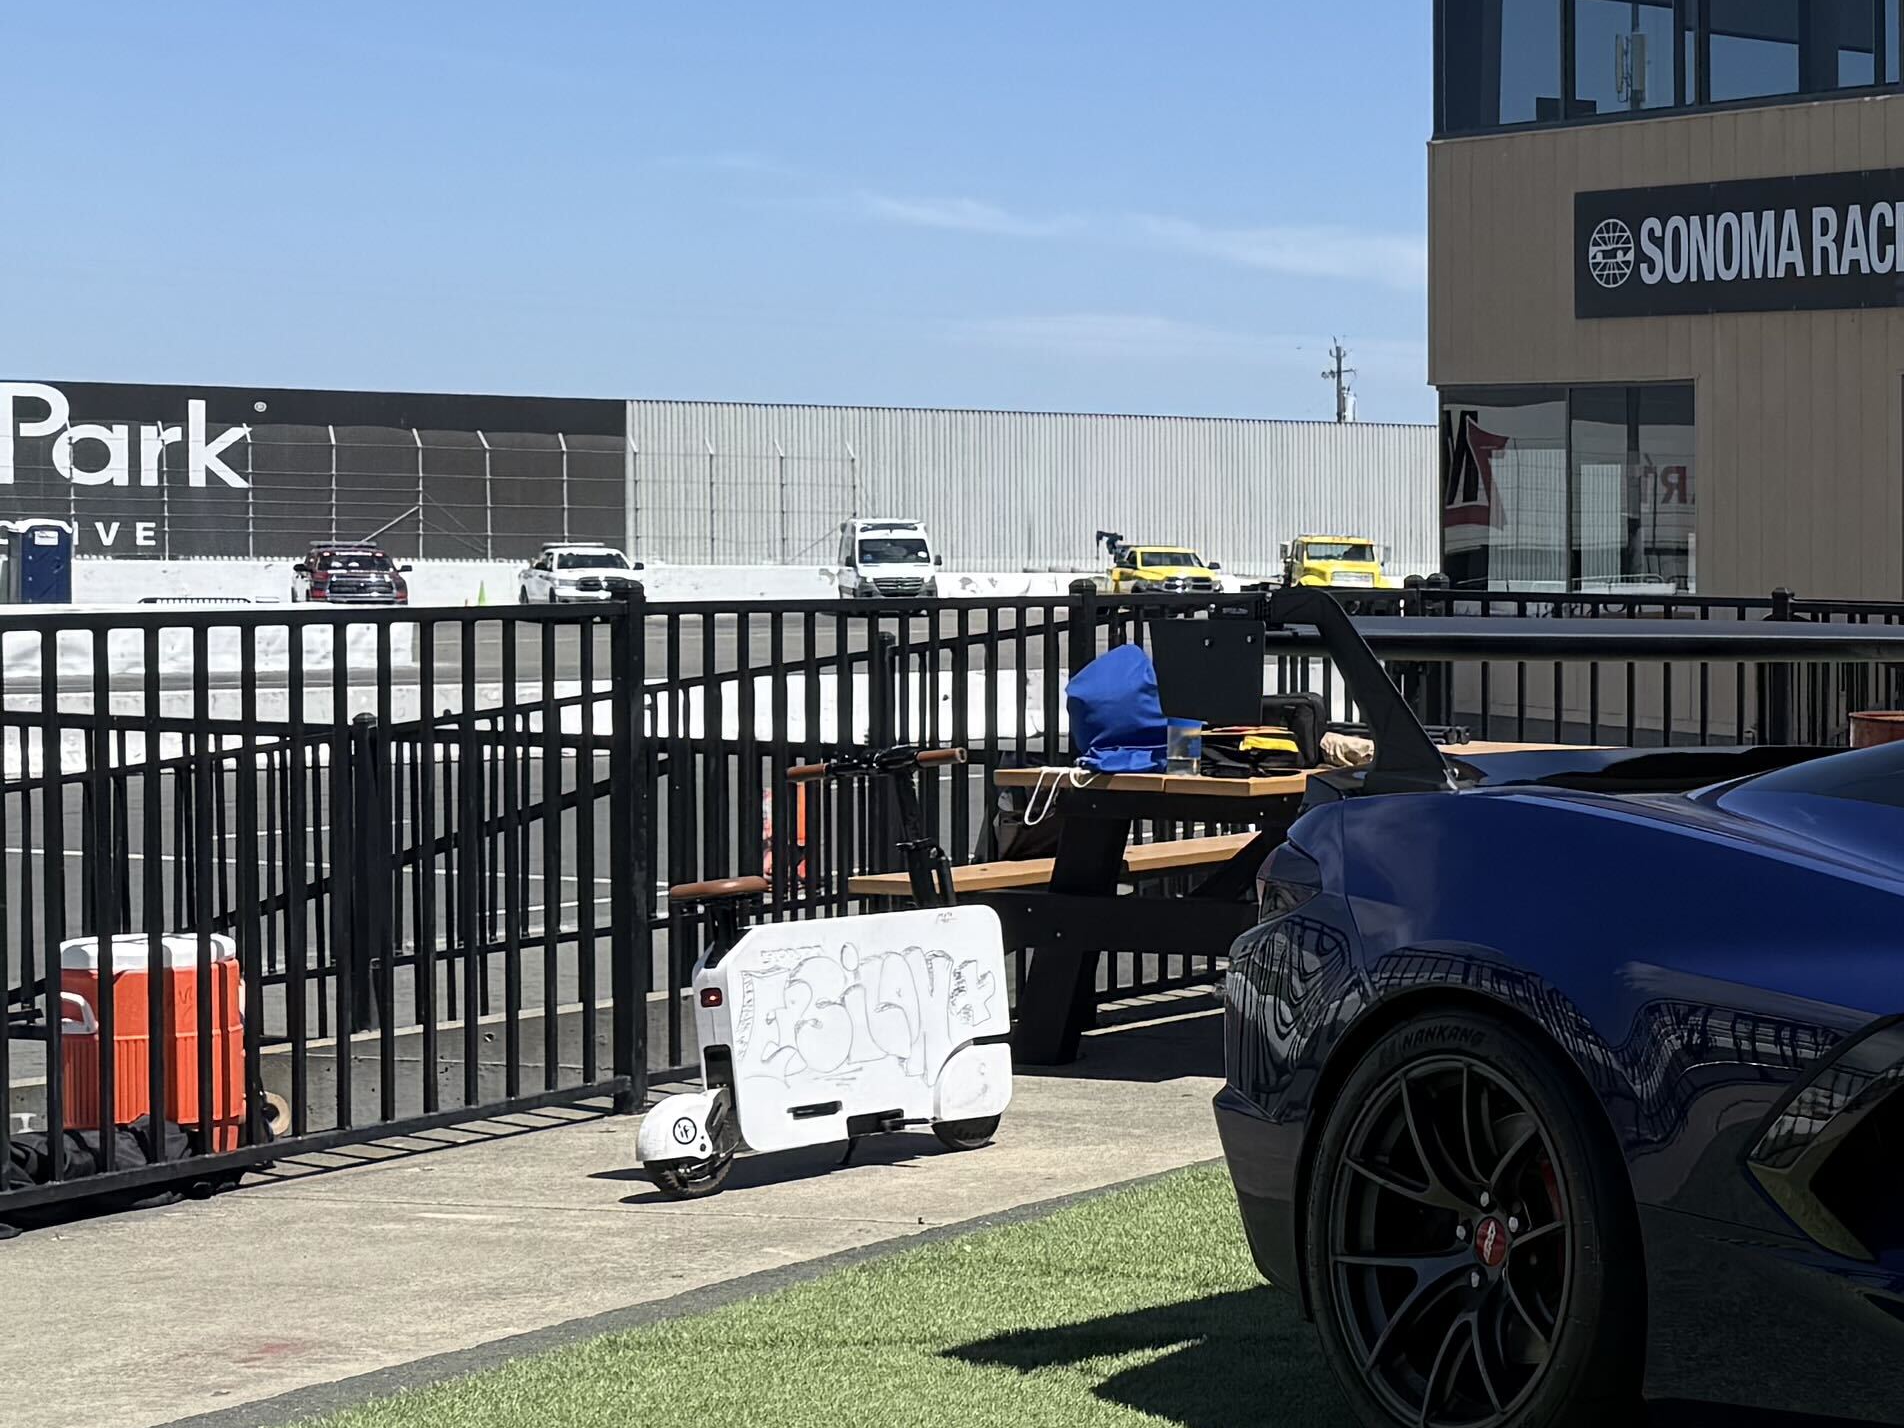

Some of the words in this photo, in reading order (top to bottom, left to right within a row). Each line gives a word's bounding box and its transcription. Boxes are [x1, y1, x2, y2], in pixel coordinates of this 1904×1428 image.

[1639, 208, 1806, 285] SONOMA
[0, 382, 251, 488] Park
[1402, 1025, 1486, 1050] NANKANG
